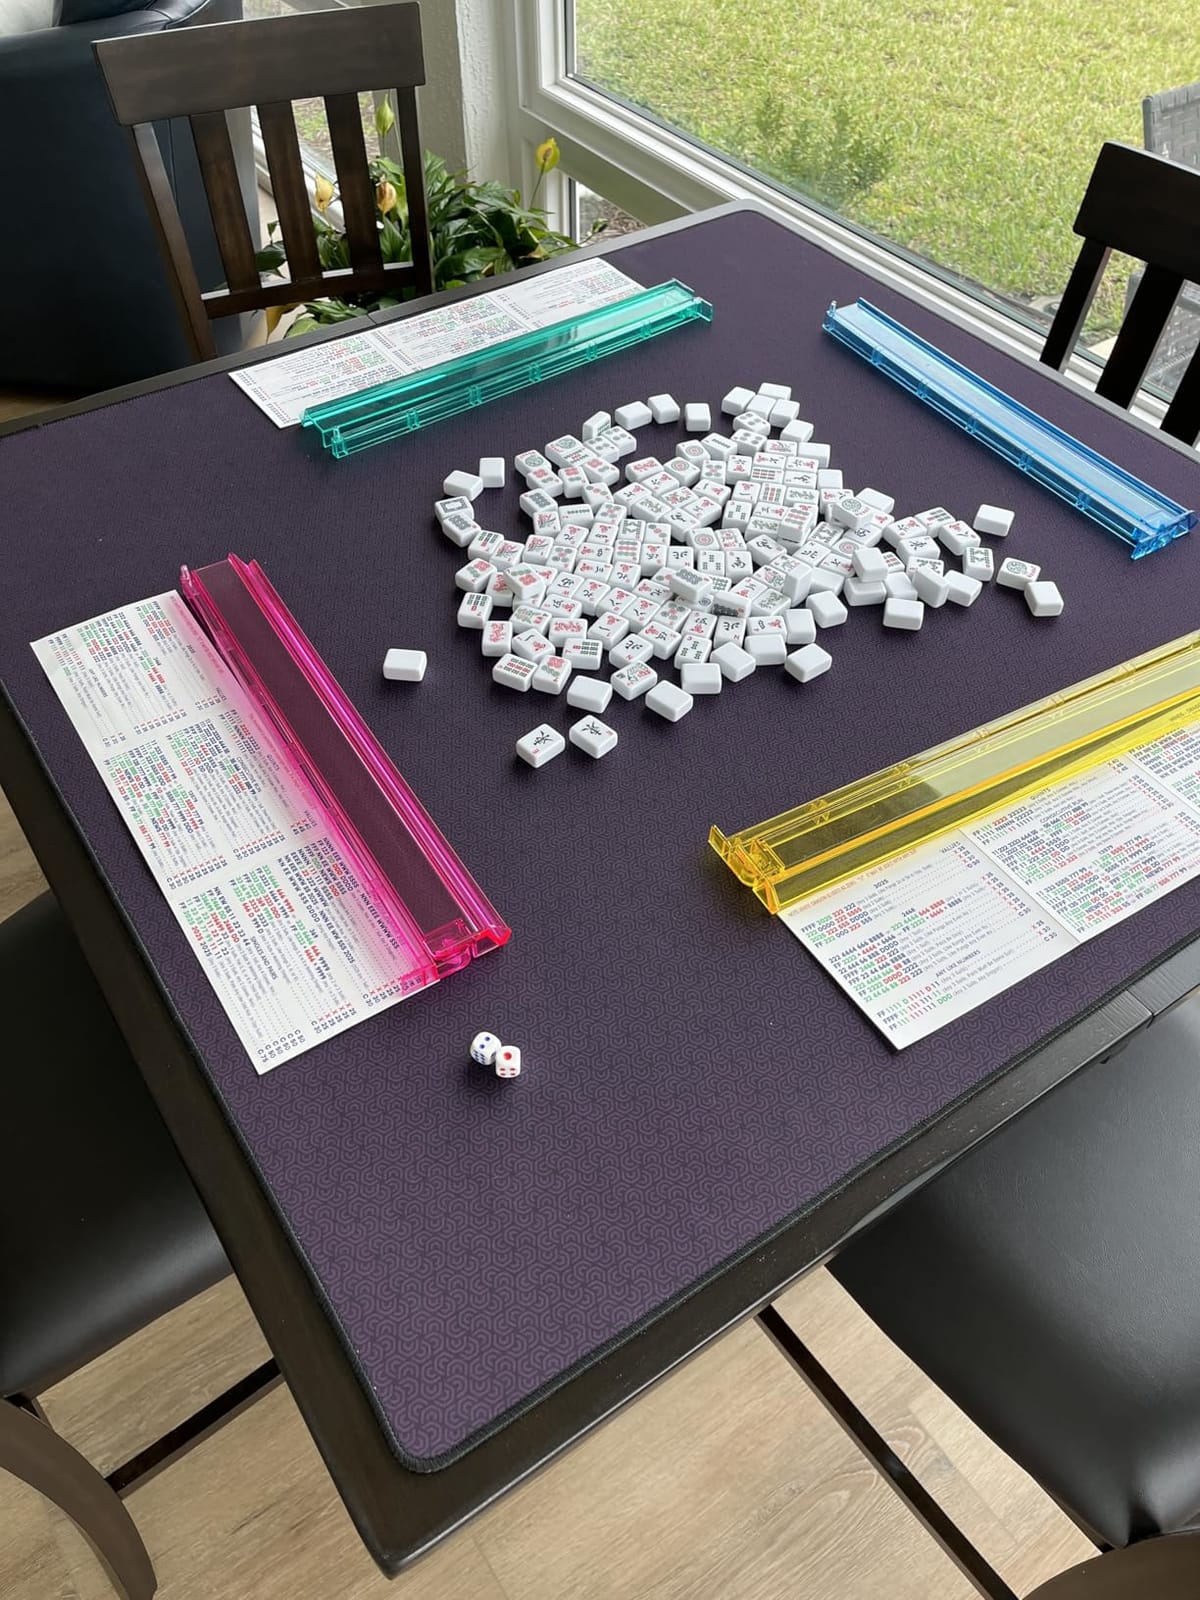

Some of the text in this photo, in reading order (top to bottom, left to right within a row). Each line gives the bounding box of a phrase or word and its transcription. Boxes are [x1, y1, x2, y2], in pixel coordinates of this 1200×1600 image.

[260, 954, 270, 965] AND
[945, 962, 958, 971] LIKE
[955, 949, 981, 965] NUMBERS
